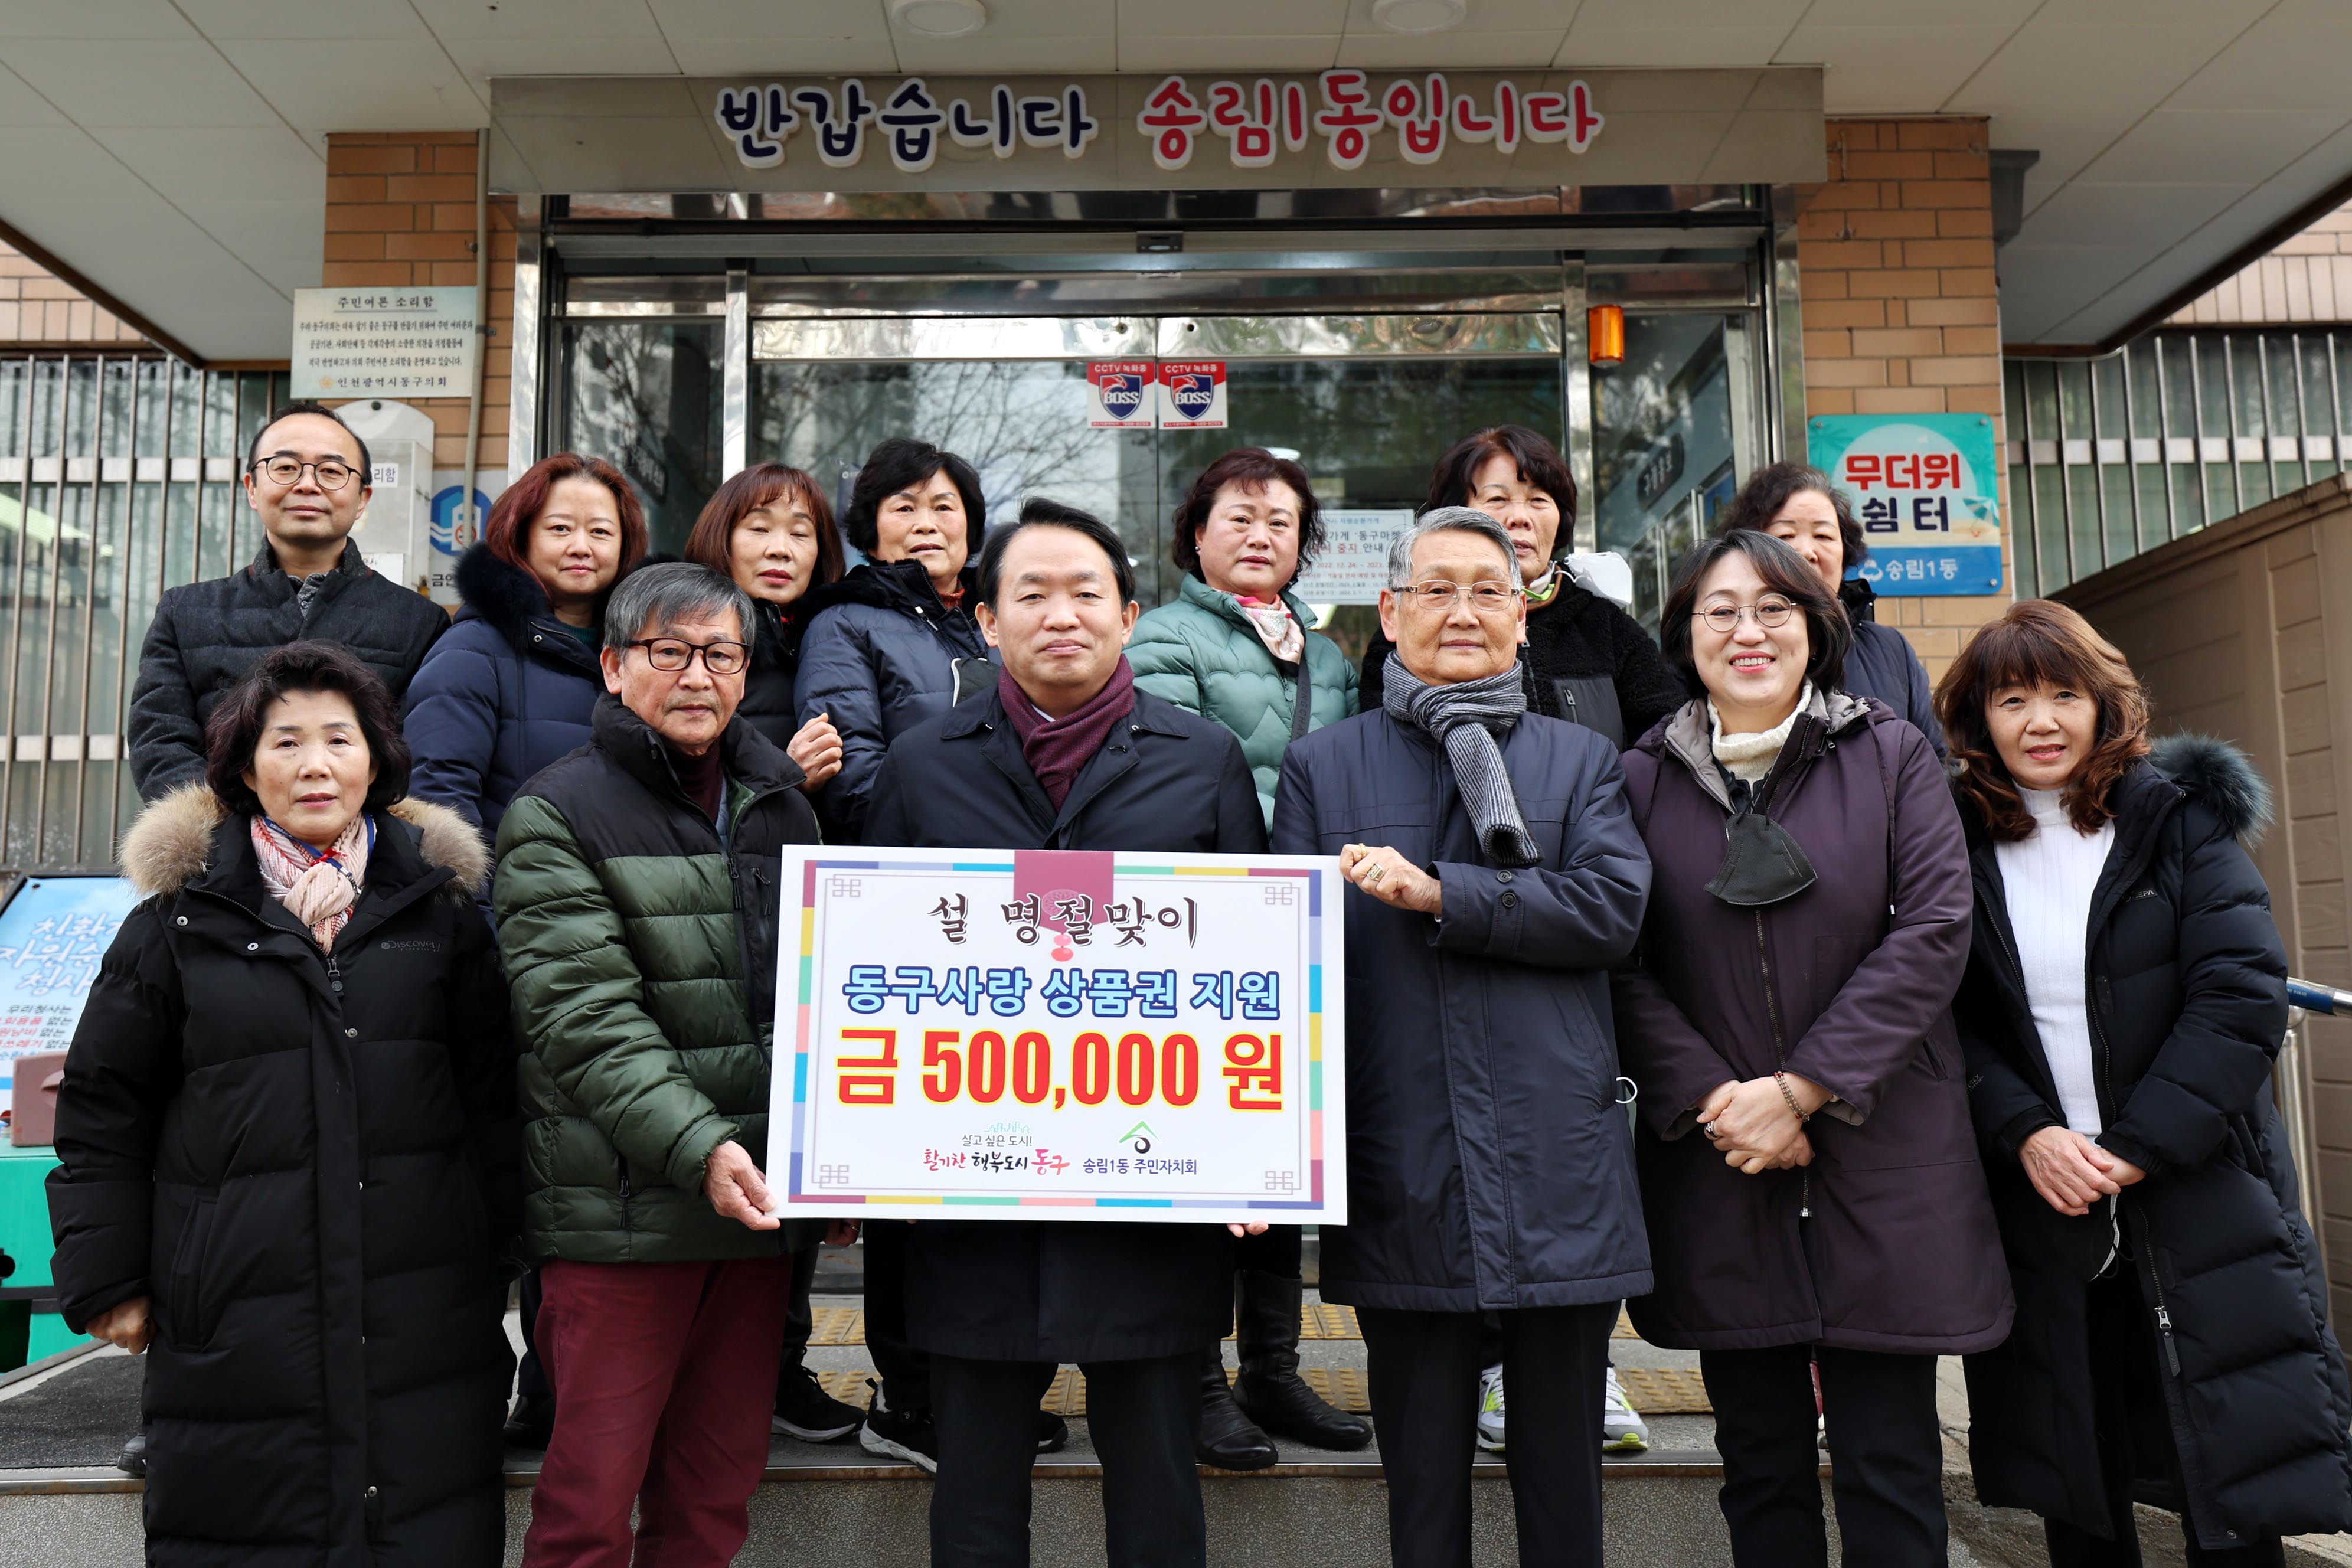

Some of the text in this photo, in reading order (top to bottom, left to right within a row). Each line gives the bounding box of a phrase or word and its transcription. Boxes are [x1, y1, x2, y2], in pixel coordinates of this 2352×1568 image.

[718, 79, 1097, 169] 반갑습니다
[338, 296, 433, 308] 주민여론 소리함
[300, 321, 311, 331] 우리
[400, 320, 417, 331] 만들기
[437, 320, 449, 331] 주민
[1094, 364, 1146, 373] CCTV 녹화중
[1165, 364, 1218, 373] CCTV 녹화중
[1103, 391, 1139, 404] BOSS
[1175, 391, 1211, 405] BOSS
[1845, 453, 1961, 491] 무더위
[1325, 531, 1350, 541] 가게
[1337, 543, 1357, 554] 중지
[1362, 543, 1383, 553] 안내
[1885, 558, 1959, 581] 송림1동
[927, 893, 1197, 949] 설 명절맞이
[842, 964, 1281, 1020] 동구사랑 상품권 지원
[835, 1027, 1285, 1112] 금 500,000 원
[961, 1134, 1033, 1147] 살고 싶은 도시!
[923, 1148, 1070, 1176] 활기찬 행복도시 동구
[1083, 1158, 1197, 1175] 송림1동 주민자치회
